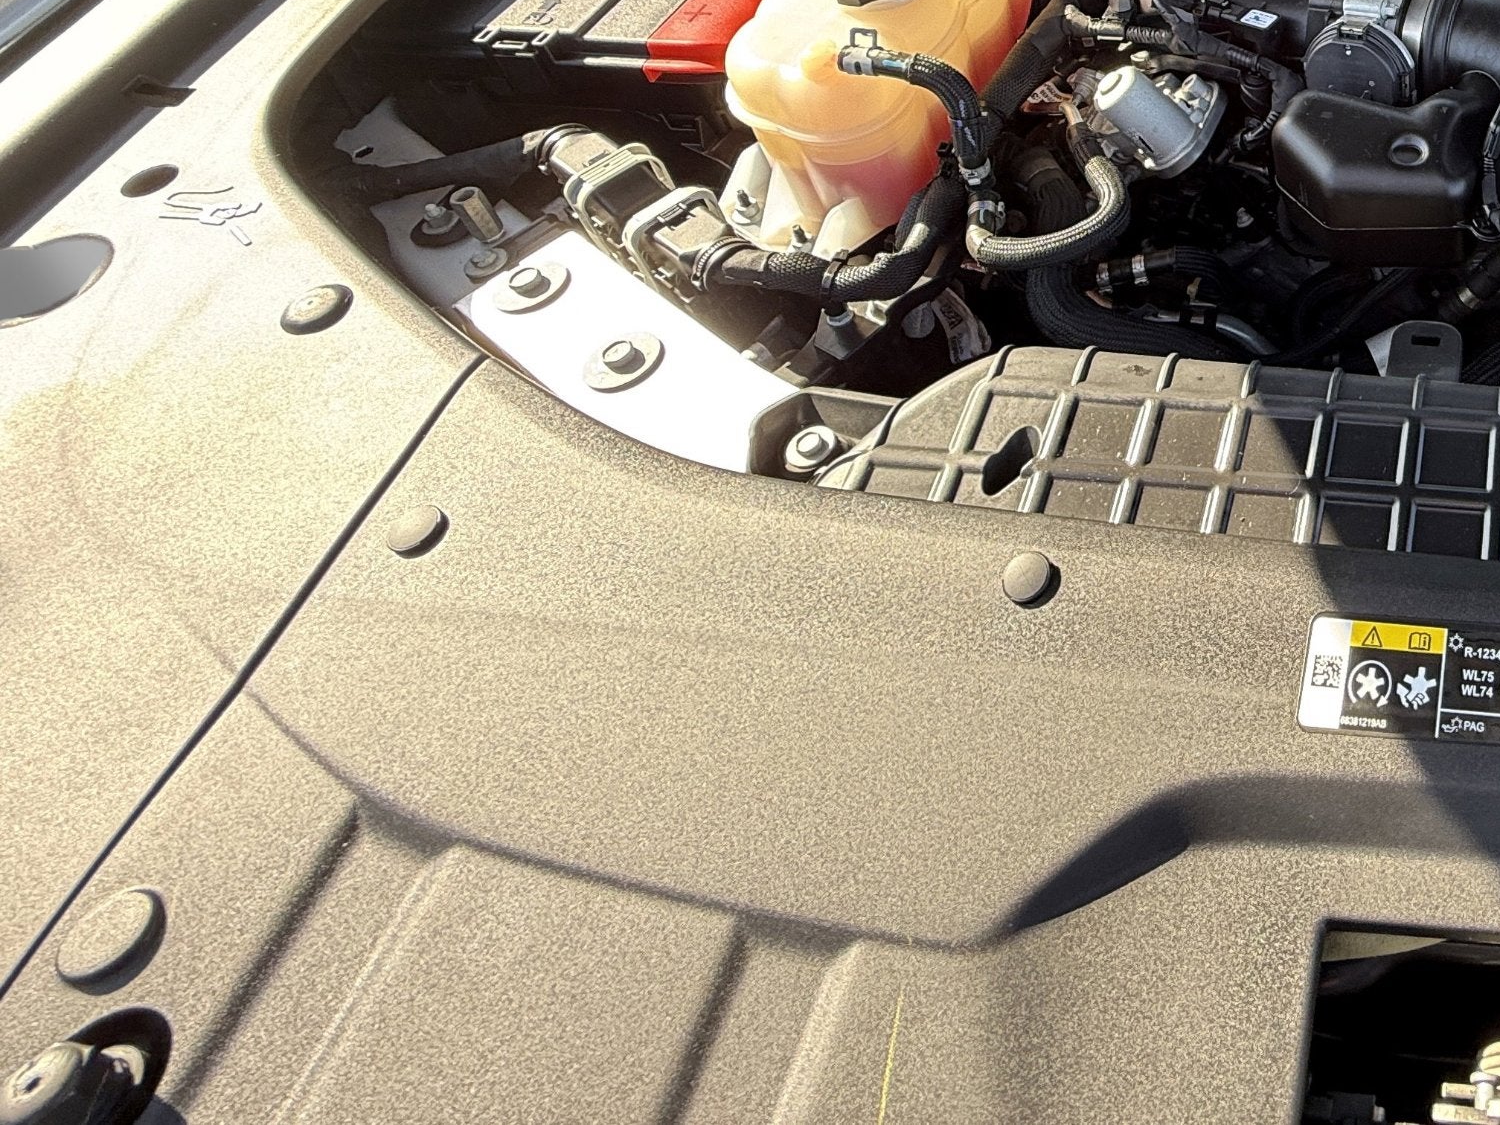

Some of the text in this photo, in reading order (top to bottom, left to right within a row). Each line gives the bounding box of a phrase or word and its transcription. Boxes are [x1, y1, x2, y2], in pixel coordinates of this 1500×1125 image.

[1462, 668, 1495, 683] WL75
[1461, 684, 1494, 698] WL74
[1463, 721, 1485, 733] PAG
